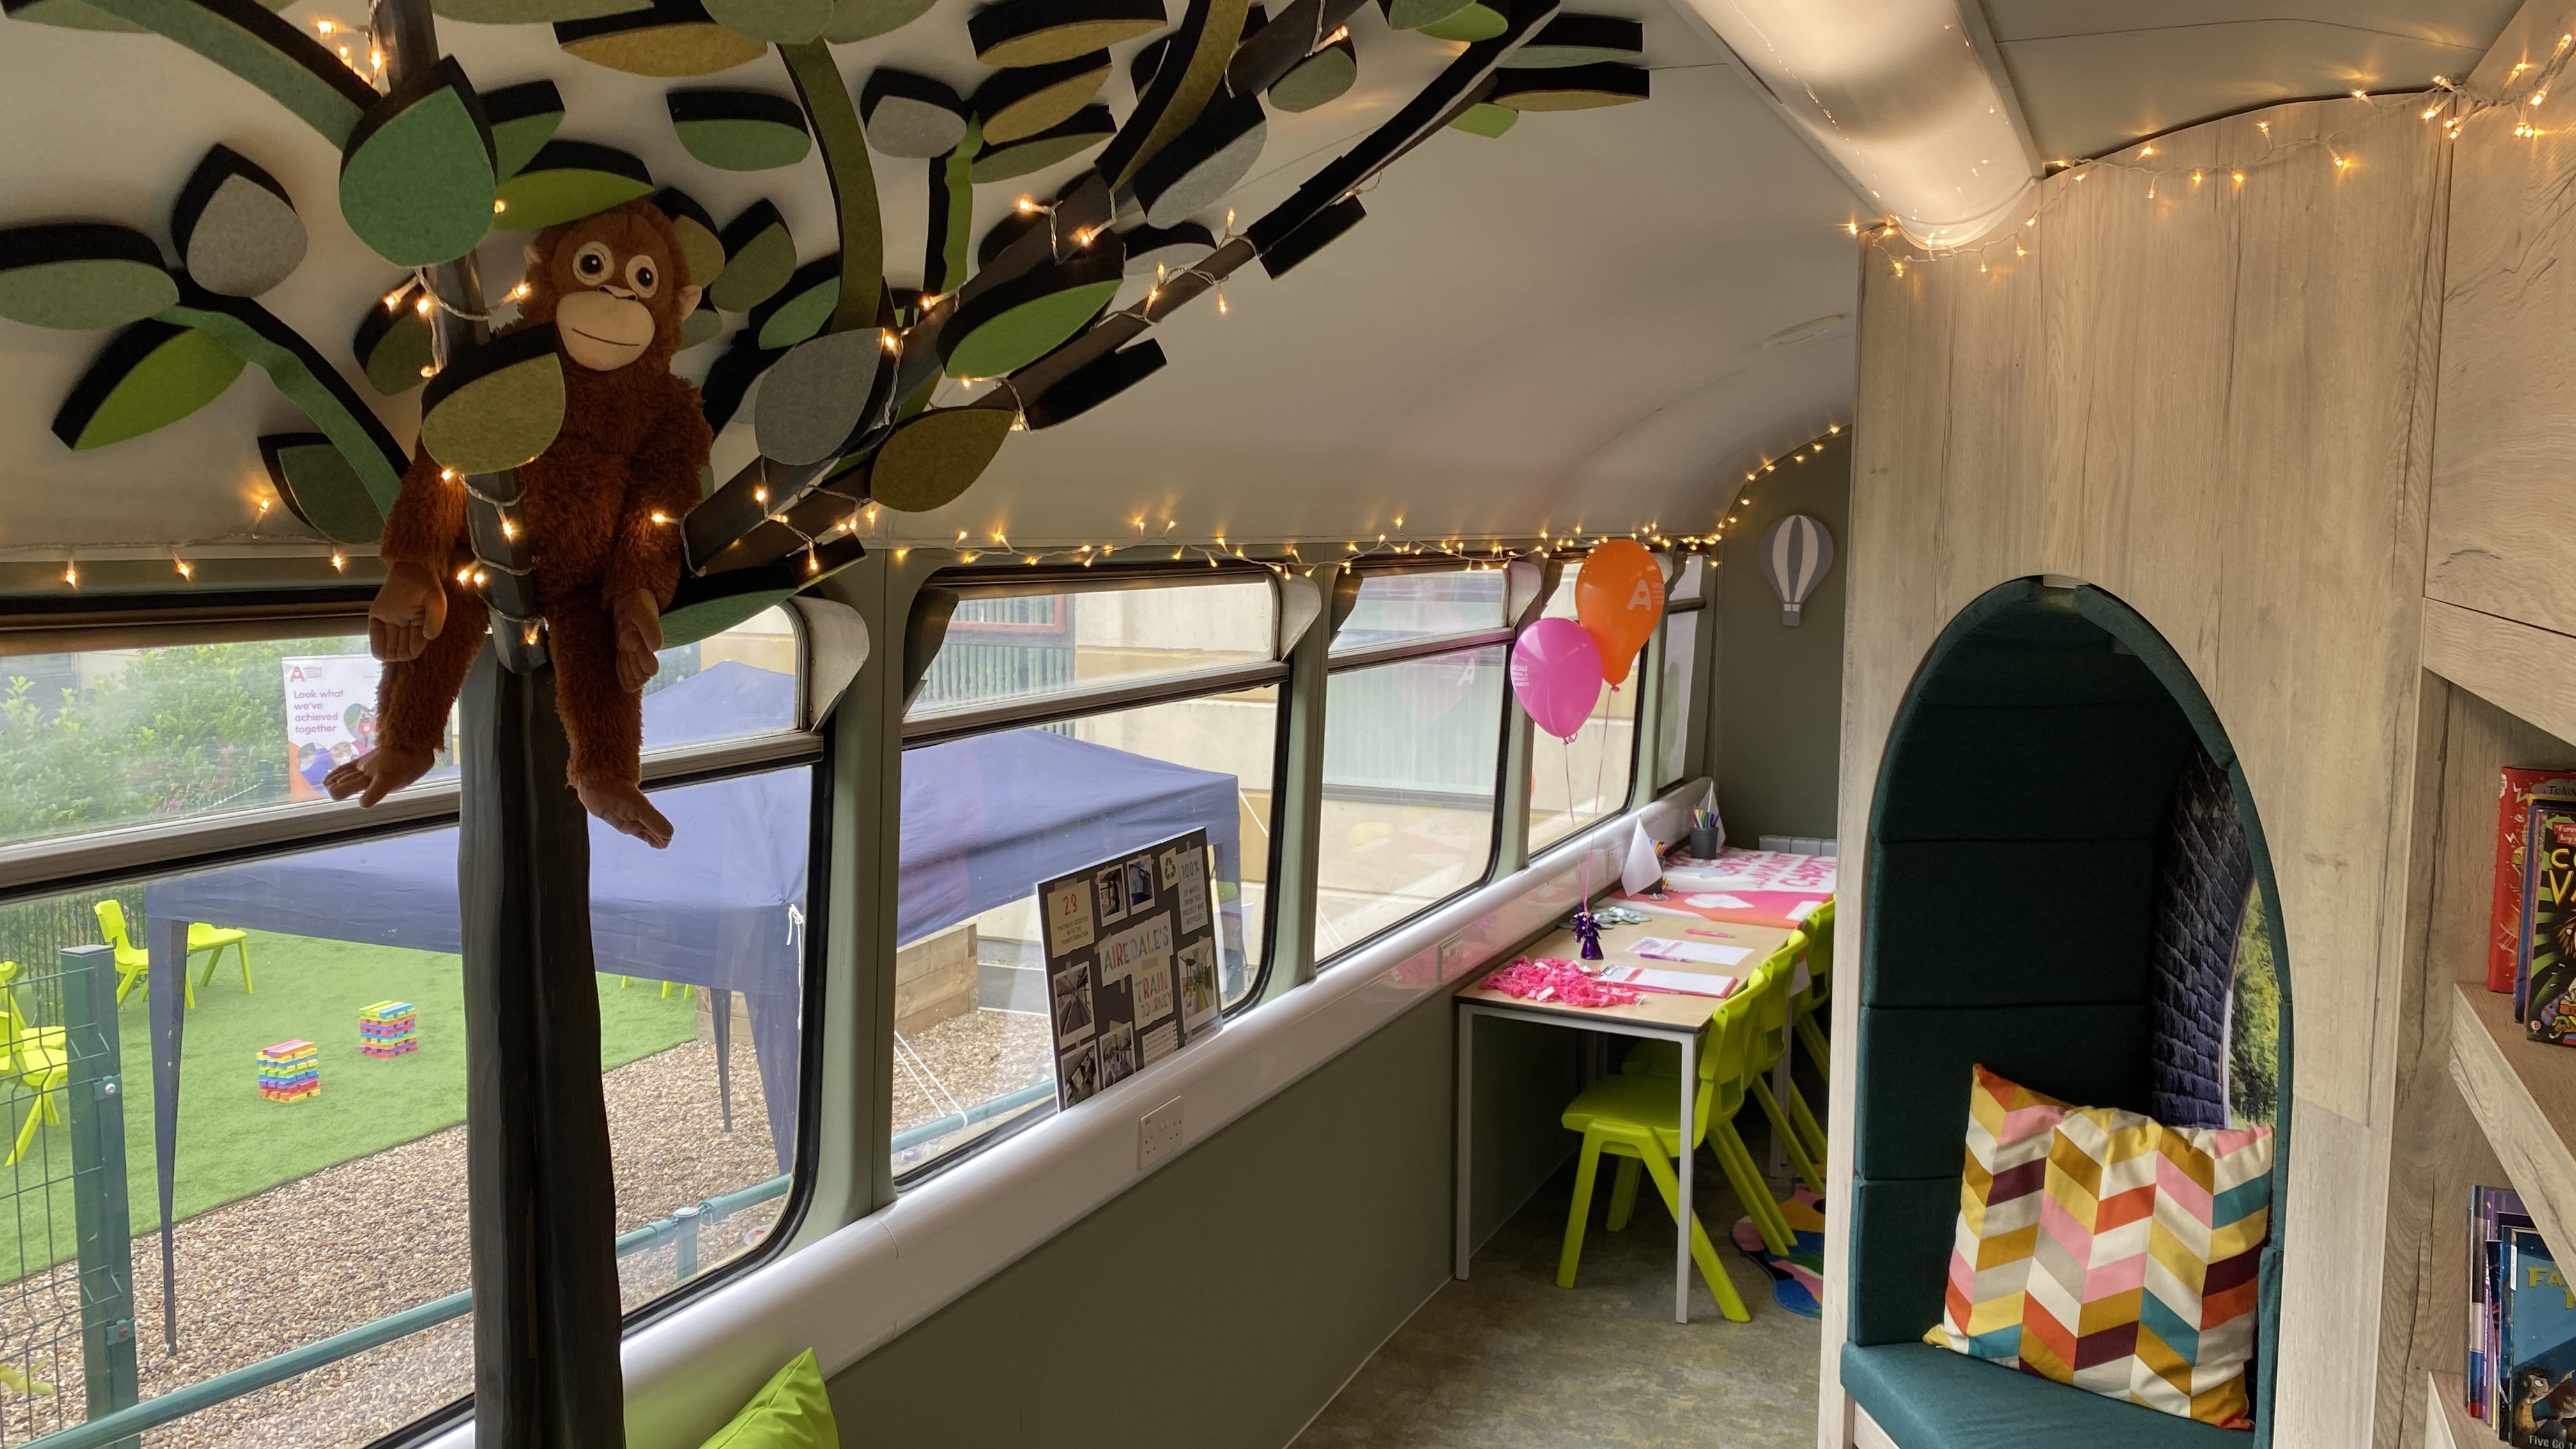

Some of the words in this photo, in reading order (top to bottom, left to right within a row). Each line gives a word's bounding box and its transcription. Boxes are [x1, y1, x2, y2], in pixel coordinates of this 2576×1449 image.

[1627, 579, 1652, 611] A
[290, 666, 306, 683] A
[294, 690, 317, 699] Look
[319, 689, 344, 698] what
[294, 702, 323, 710] we've
[295, 712, 338, 722] achieved
[295, 724, 337, 735] together
[1181, 859, 1199, 879] 100%
[2551, 848, 2576, 870] C
[2549, 870, 2576, 907] V
[1063, 893, 1077, 916] 23
[1104, 925, 1169, 973] AIREDALE'S
[1135, 969, 1169, 1003] TRAIN
[1140, 990, 1173, 1019] JOURNEY
[2527, 1267, 2569, 1287] FA
[2529, 1435, 2549, 1447] Five
[2552, 1439, 2564, 1449] Go
